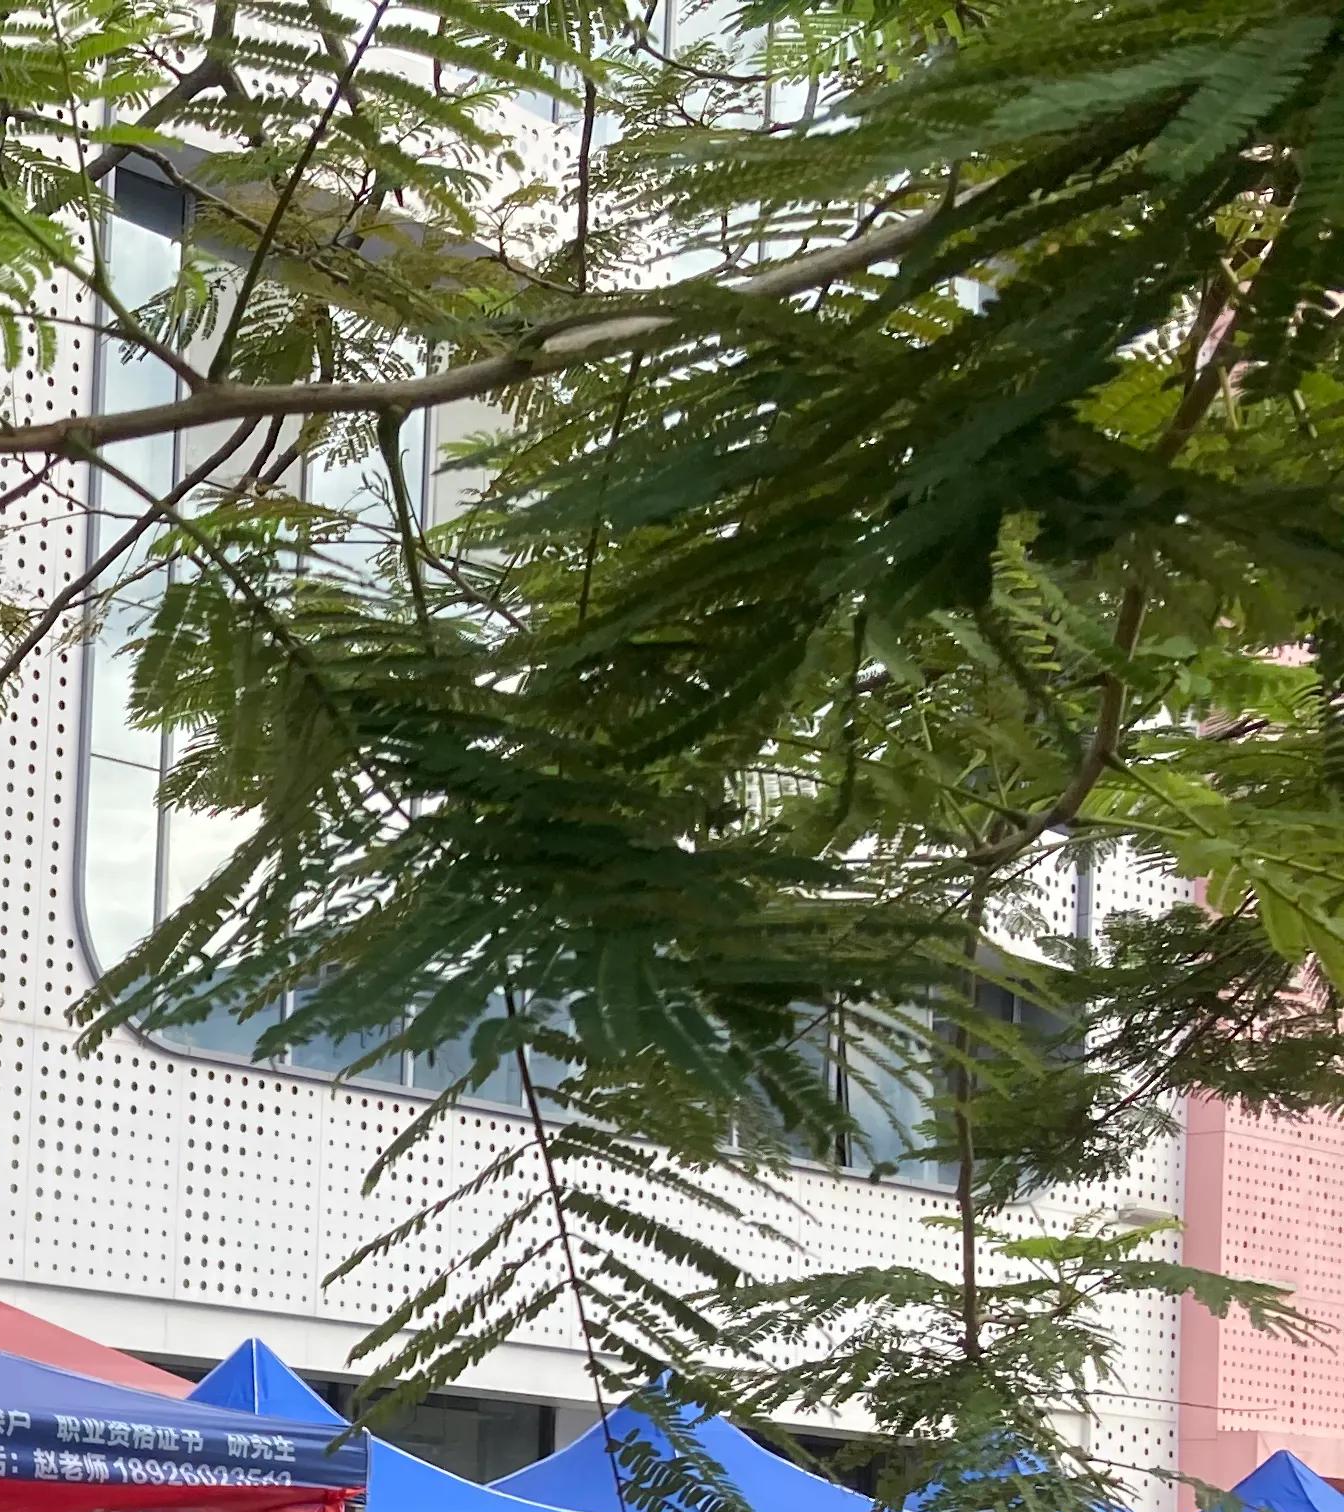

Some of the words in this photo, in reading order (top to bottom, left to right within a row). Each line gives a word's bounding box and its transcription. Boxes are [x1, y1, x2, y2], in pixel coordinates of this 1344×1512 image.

[54, 1413, 205, 1453] 职业资格证书
[226, 1431, 297, 1463] 研究生
